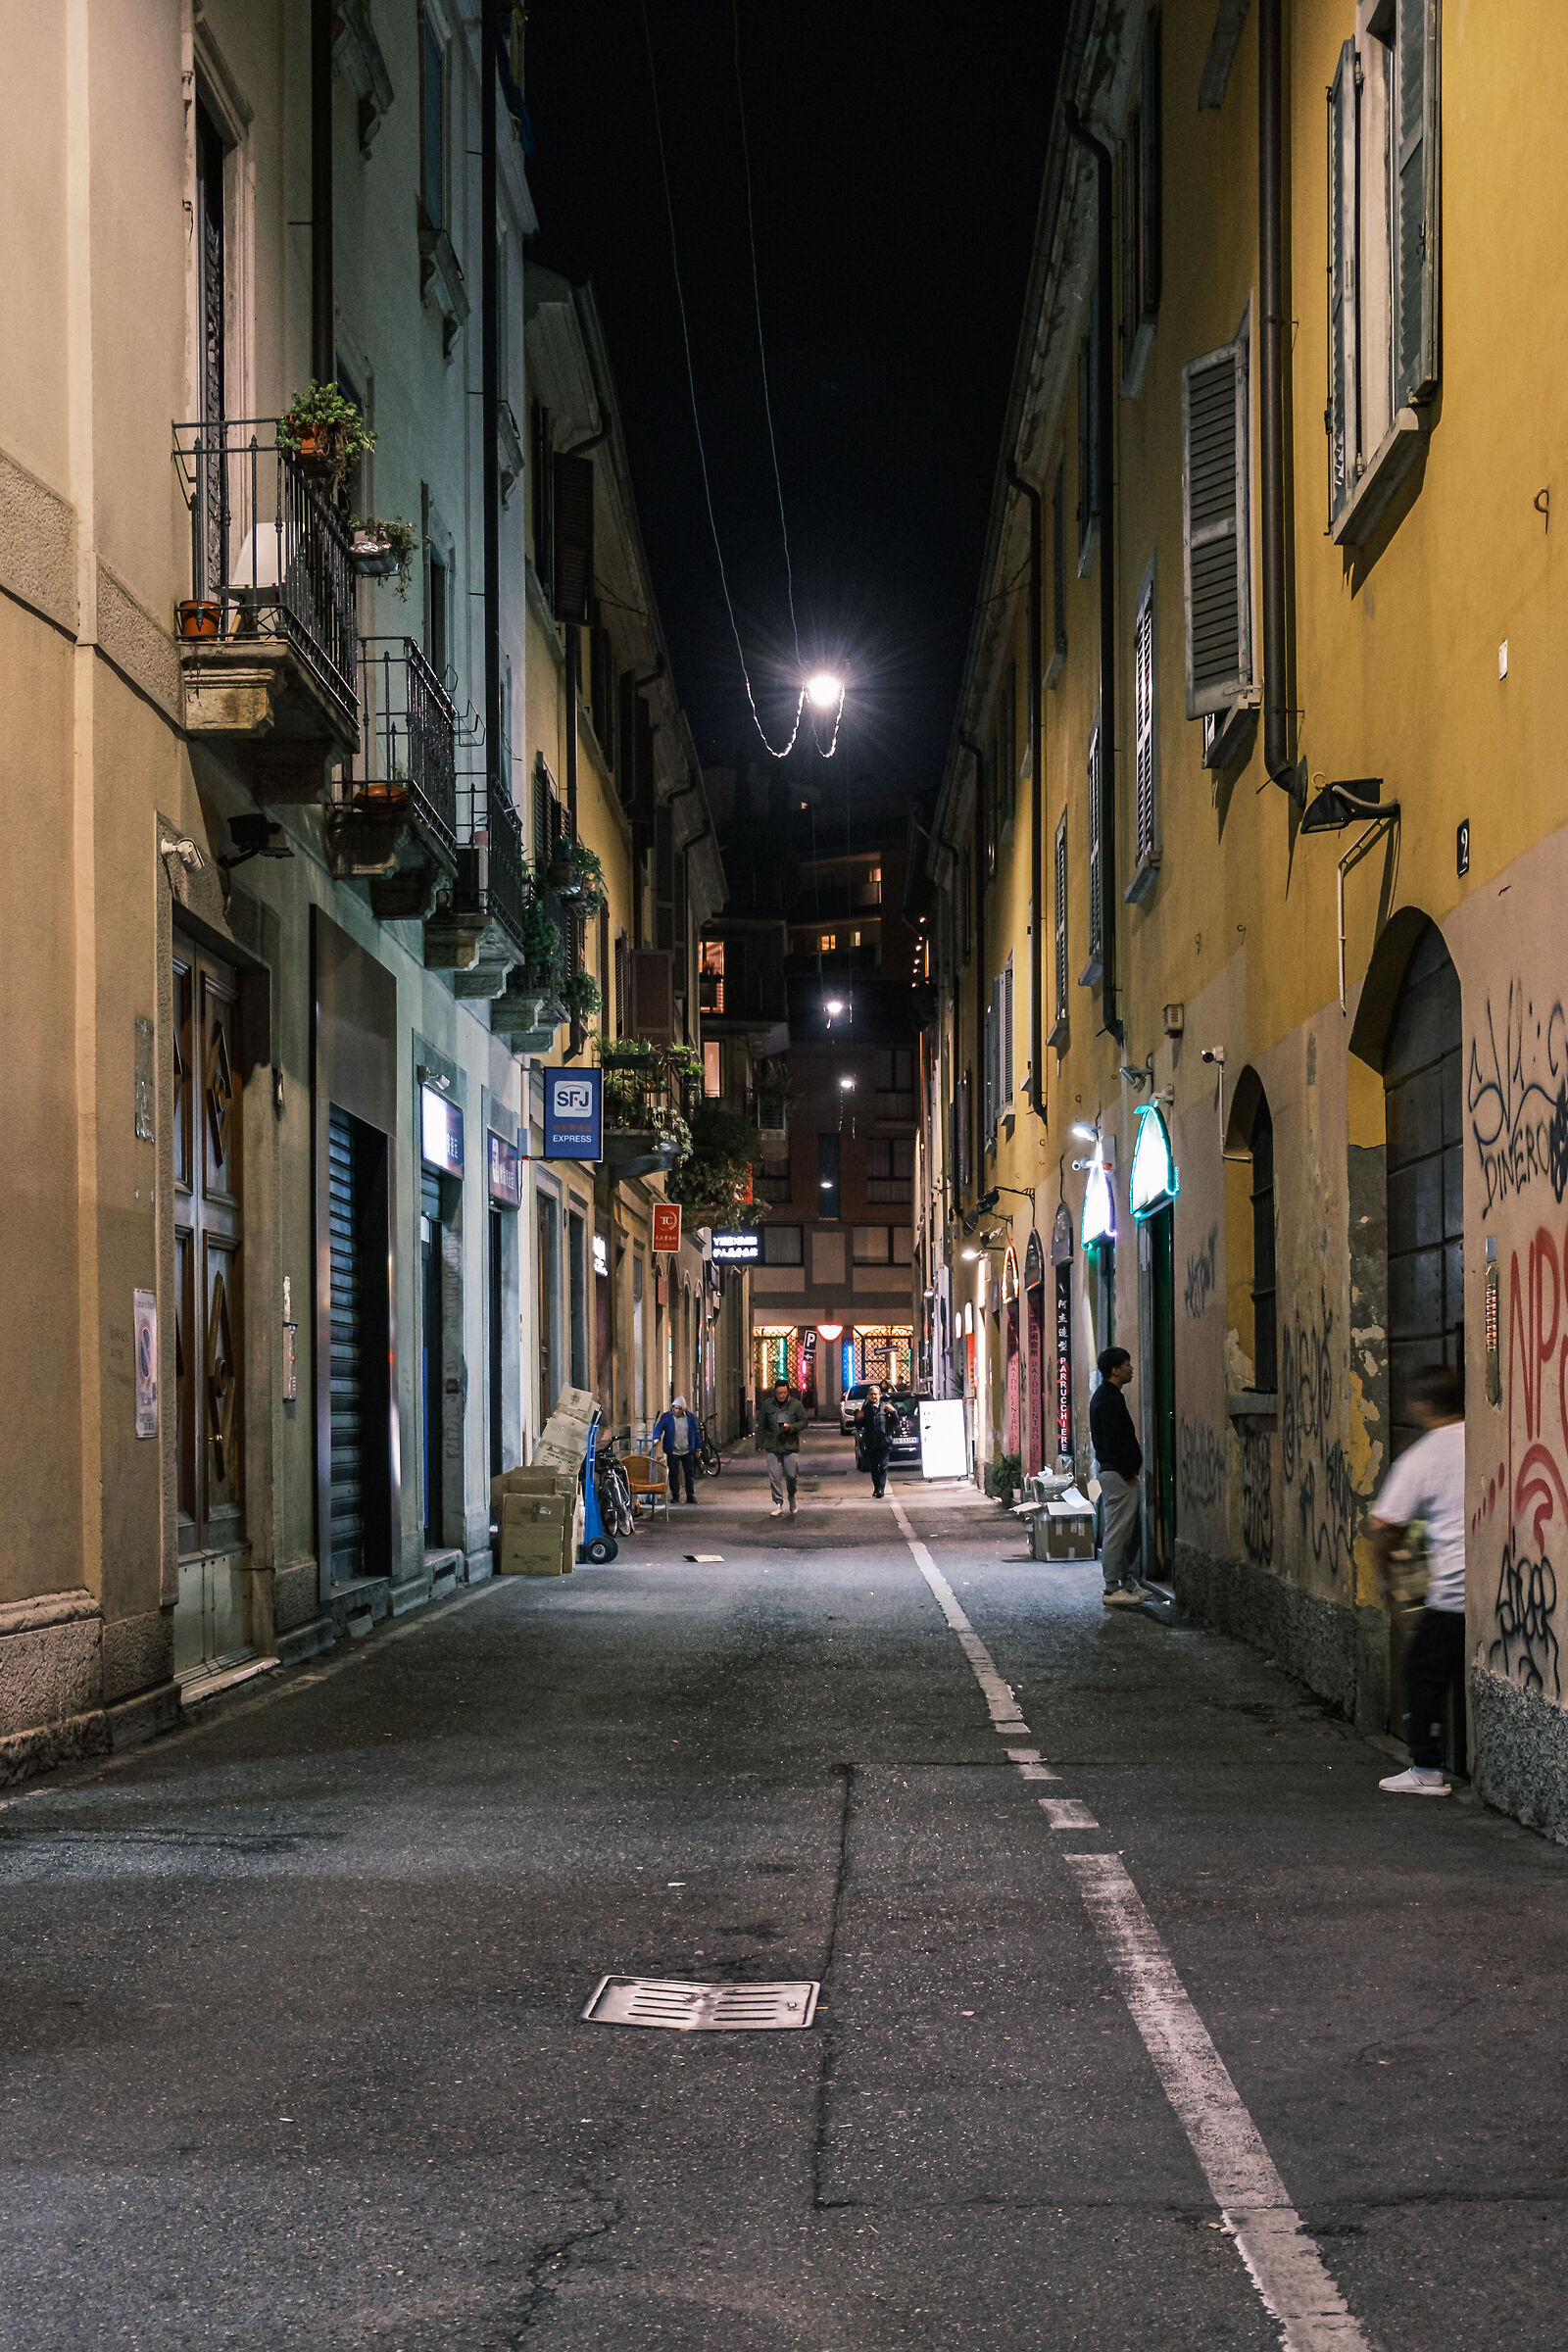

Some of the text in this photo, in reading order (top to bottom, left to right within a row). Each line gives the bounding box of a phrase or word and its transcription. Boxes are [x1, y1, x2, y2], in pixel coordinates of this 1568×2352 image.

[557, 1091, 589, 1107] SFJ
[661, 1216, 673, 1226] TC
[807, 1333, 816, 1348] P
